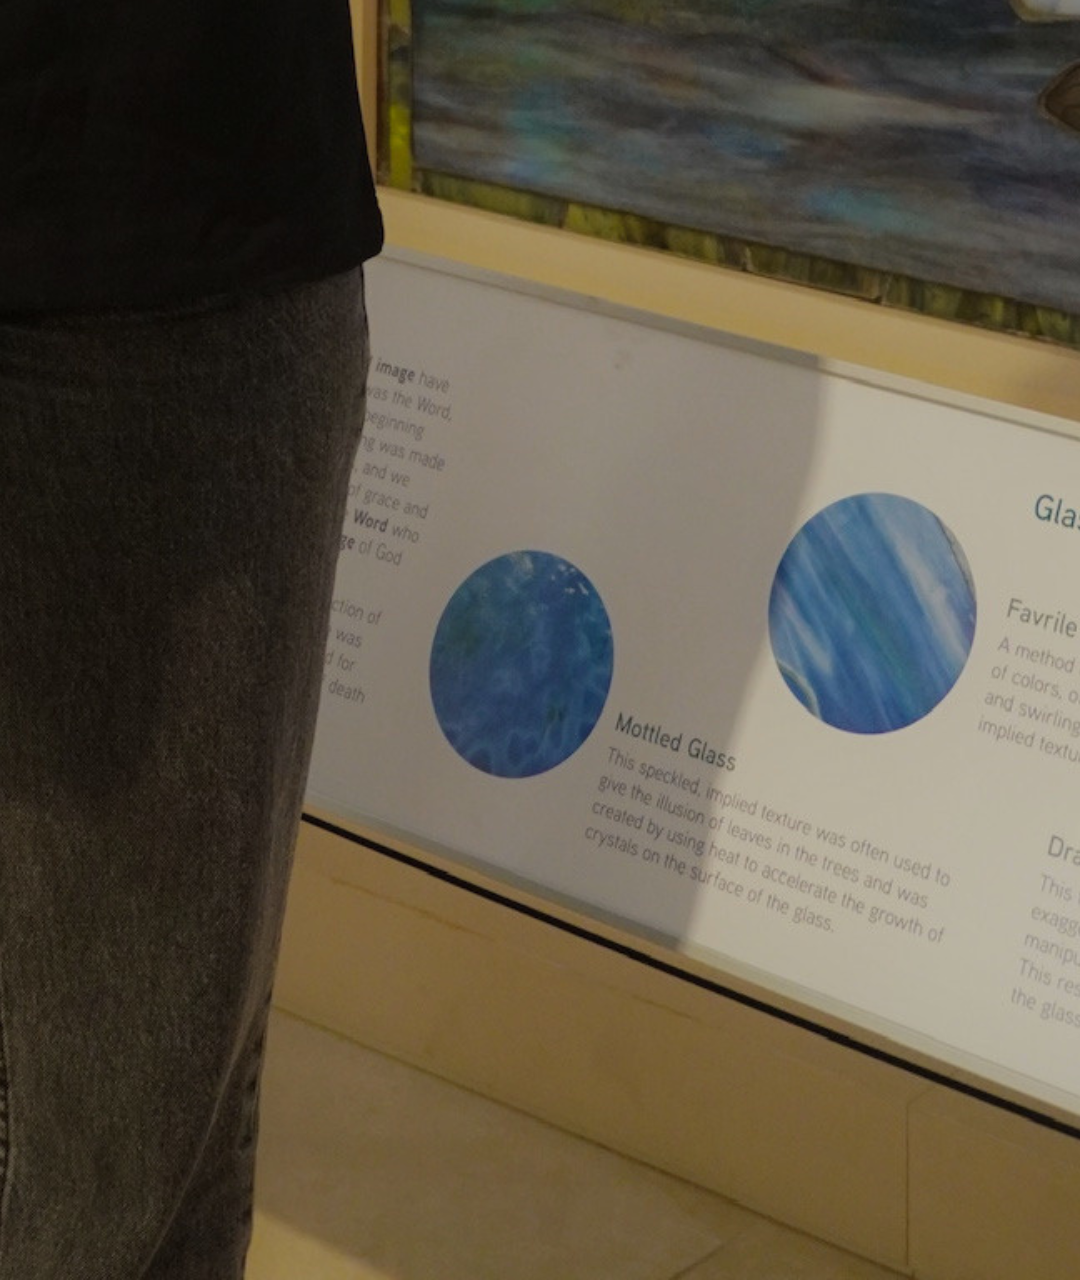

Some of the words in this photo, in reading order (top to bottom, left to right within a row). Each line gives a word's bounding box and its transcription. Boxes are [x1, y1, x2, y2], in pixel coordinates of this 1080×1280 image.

[375, 357, 416, 384] image
[419, 370, 450, 393] have
[391, 389, 413, 409] the
[417, 395, 452, 423] Word,
[362, 460, 387, 480] and
[390, 471, 411, 488] we
[379, 441, 405, 460] was
[408, 448, 446, 473] made
[363, 488, 401, 511] grace
[402, 501, 429, 520] and
[1034, 494, 1080, 532] Gla
[353, 508, 389, 533] Word
[392, 522, 420, 544] who
[358, 539, 373, 555] of
[375, 542, 403, 567] God
[367, 610, 383, 626] of
[1006, 597, 1079, 639] Favrile
[336, 630, 362, 649] was
[997, 636, 1010, 653] A
[1014, 645, 1076, 675] method
[337, 654, 356, 673] for
[328, 678, 366, 704] death
[991, 663, 1008, 680] of
[1011, 670, 1063, 701] colors,
[984, 690, 1014, 714] and
[614, 712, 683, 753] Mottled
[687, 737, 737, 772] Glass
[977, 714, 1036, 749] implied
[607, 746, 635, 772] This
[638, 761, 702, 798] speckled,
[705, 784, 758, 816] implied
[761, 804, 812, 836] texture
[816, 826, 846, 850] was
[850, 839, 890, 865] often
[893, 854, 933, 881] used
[934, 868, 951, 888] to
[598, 775, 627, 796] give
[631, 783, 653, 806] the
[656, 792, 705, 826] illusion
[708, 816, 725, 832] of
[727, 821, 772, 851] leaves
[776, 837, 791, 857] in
[794, 845, 818, 867] the
[822, 856, 860, 885] trees
[863, 873, 894, 896] and
[896, 886, 929, 910] was
[585, 826, 639, 857] crystals
[642, 849, 661, 865] on
[663, 853, 686, 876] the
[689, 866, 744, 897] surface
[747, 888, 764, 904] of
[766, 893, 790, 915] the
[792, 905, 835, 934] glass.
[592, 800, 645, 831] created
[646, 819, 665, 841] by
[667, 828, 705, 857] using
[708, 841, 741, 866] heat
[744, 856, 759, 873] to
[762, 865, 837, 905] accelerate
[841, 892, 866, 916] the
[868, 905, 924, 937] growth
[927, 925, 946, 944] of
[1040, 872, 1072, 902] This
[1019, 957, 1052, 987] This
[1011, 986, 1037, 1012] the
